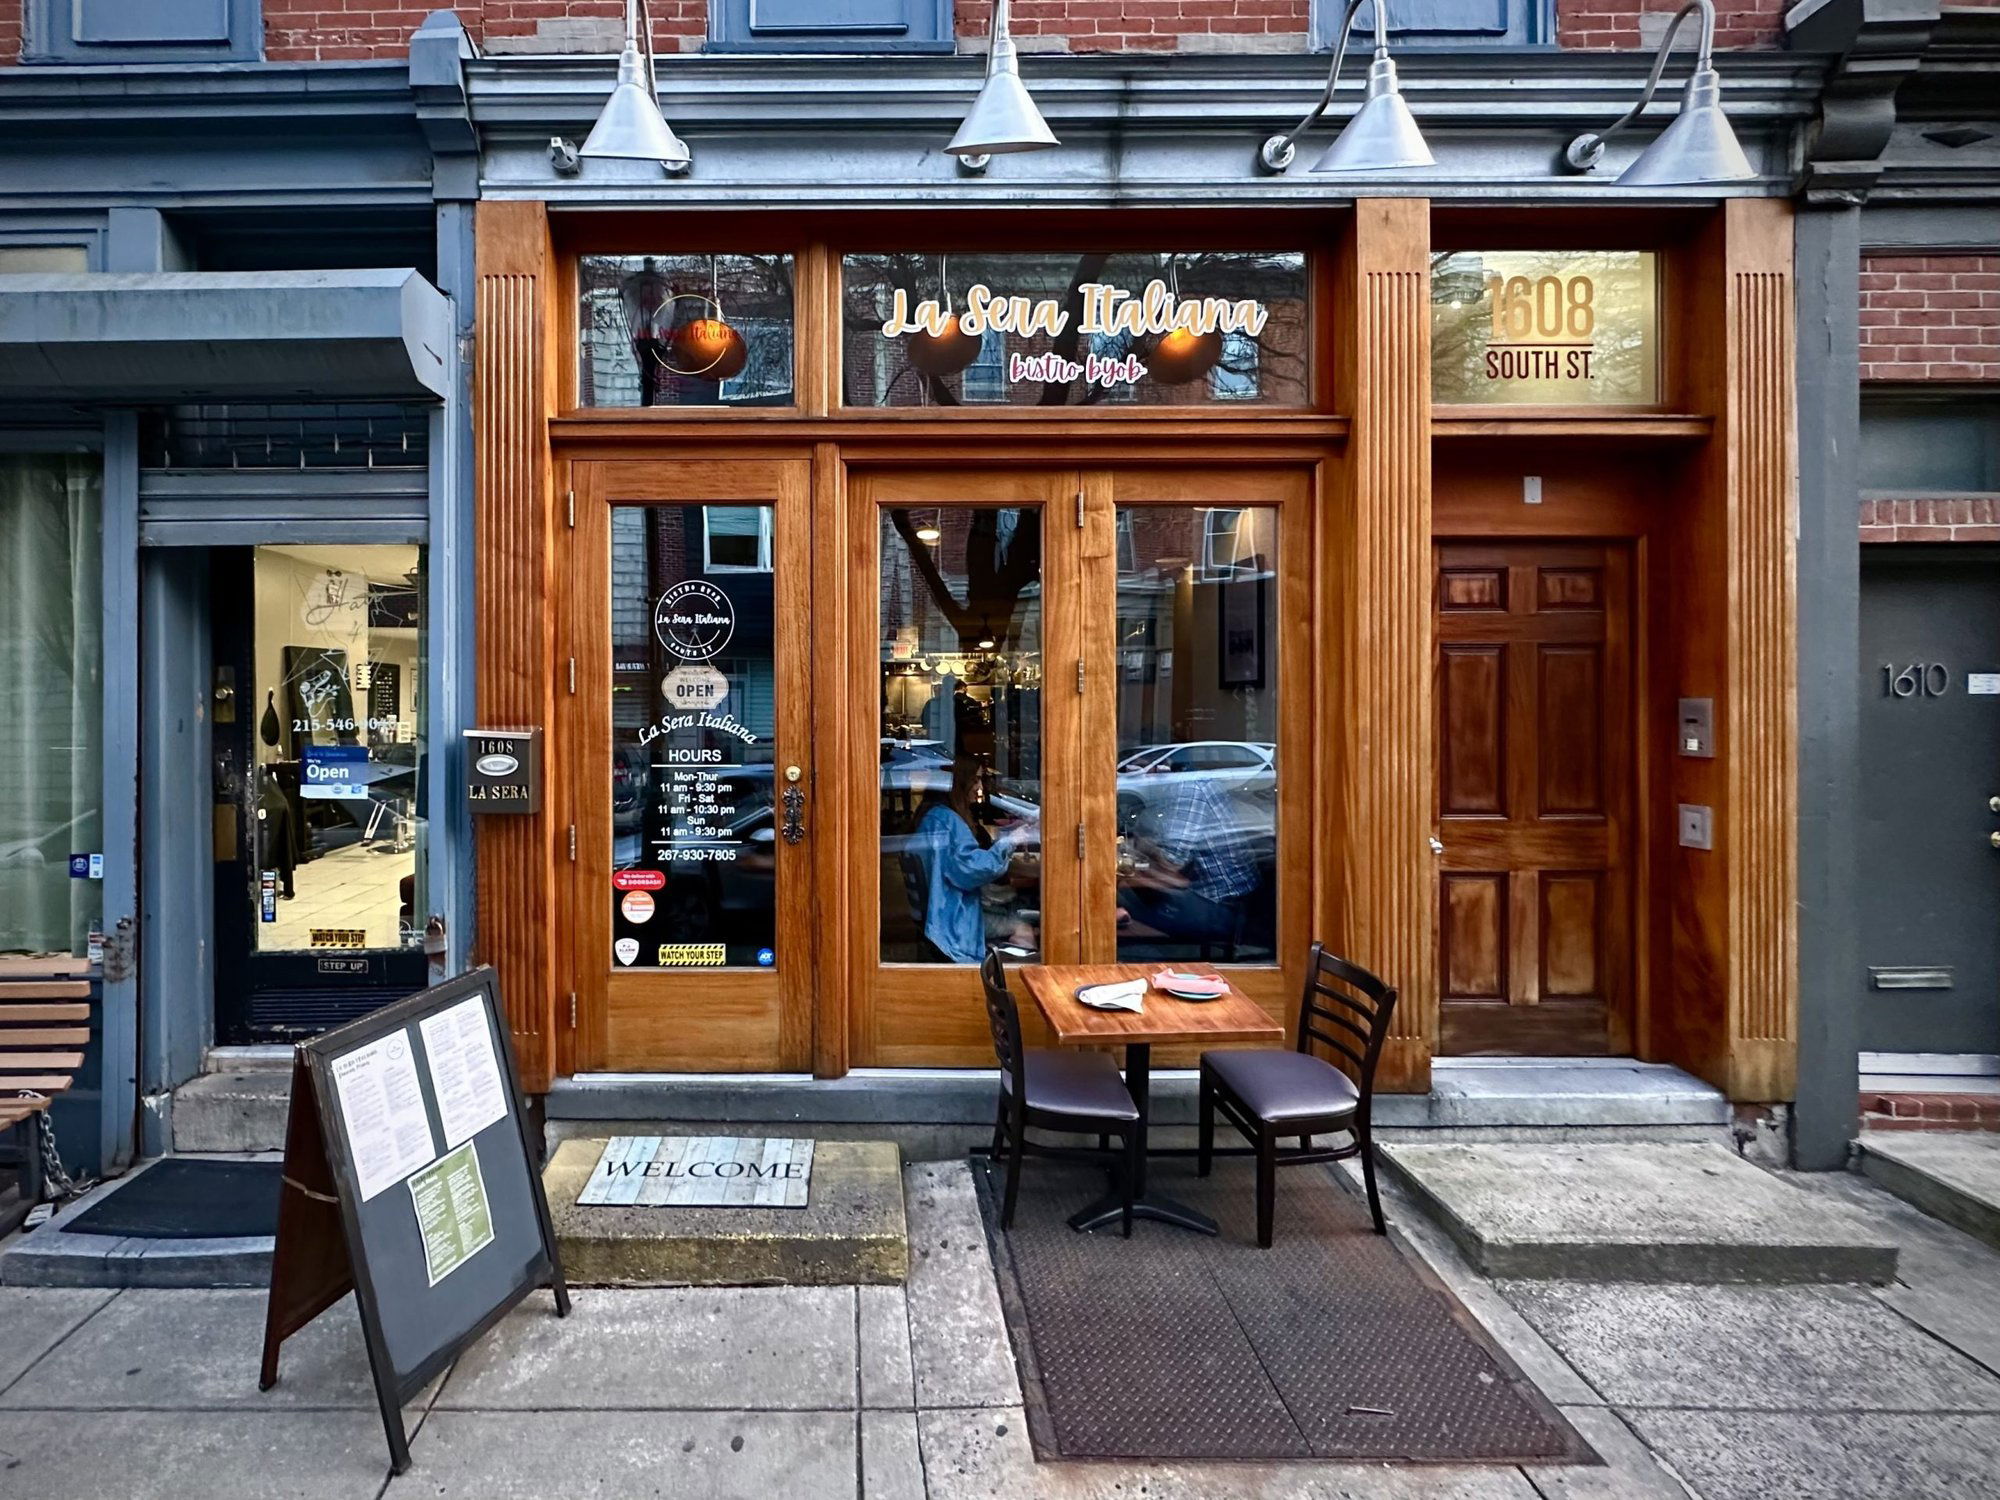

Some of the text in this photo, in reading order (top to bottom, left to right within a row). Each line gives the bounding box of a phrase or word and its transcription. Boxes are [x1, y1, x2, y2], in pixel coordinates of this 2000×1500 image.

[882, 278, 1269, 338] La Sera Italiana
[1487, 275, 1594, 338] 1608
[1009, 352, 1148, 389] bistro byob
[1486, 350, 1595, 379] SOUTH ST.
[657, 612, 731, 625] La Sera Italiana
[1884, 662, 1950, 697] 1610
[676, 684, 714, 697] OPEN
[638, 711, 758, 746] La Sera Italiana
[480, 740, 514, 754] 1608
[668, 749, 722, 762] HOURS
[306, 764, 349, 782] Open
[674, 772, 719, 781] Mon-Thur
[469, 785, 528, 799] LA SERA
[660, 783, 670, 792] 11
[695, 783, 716, 792] 9:30
[717, 785, 732, 794] pm
[678, 794, 691, 803] Fri
[698, 794, 714, 803] Sat
[658, 805, 668, 814] 11
[693, 805, 719, 814] 10:30
[720, 807, 735, 816] pm
[687, 816, 705, 825] Sun
[660, 827, 670, 836] 11
[695, 827, 716, 836] 9:30
[717, 829, 732, 838] pm
[657, 850, 736, 861] 267-930-7805
[350, 933, 364, 943] STEP
[660, 950, 723, 960] WATCH YOUR STEP
[323, 961, 364, 970] STEP UP
[605, 1160, 804, 1179] WELCOME
